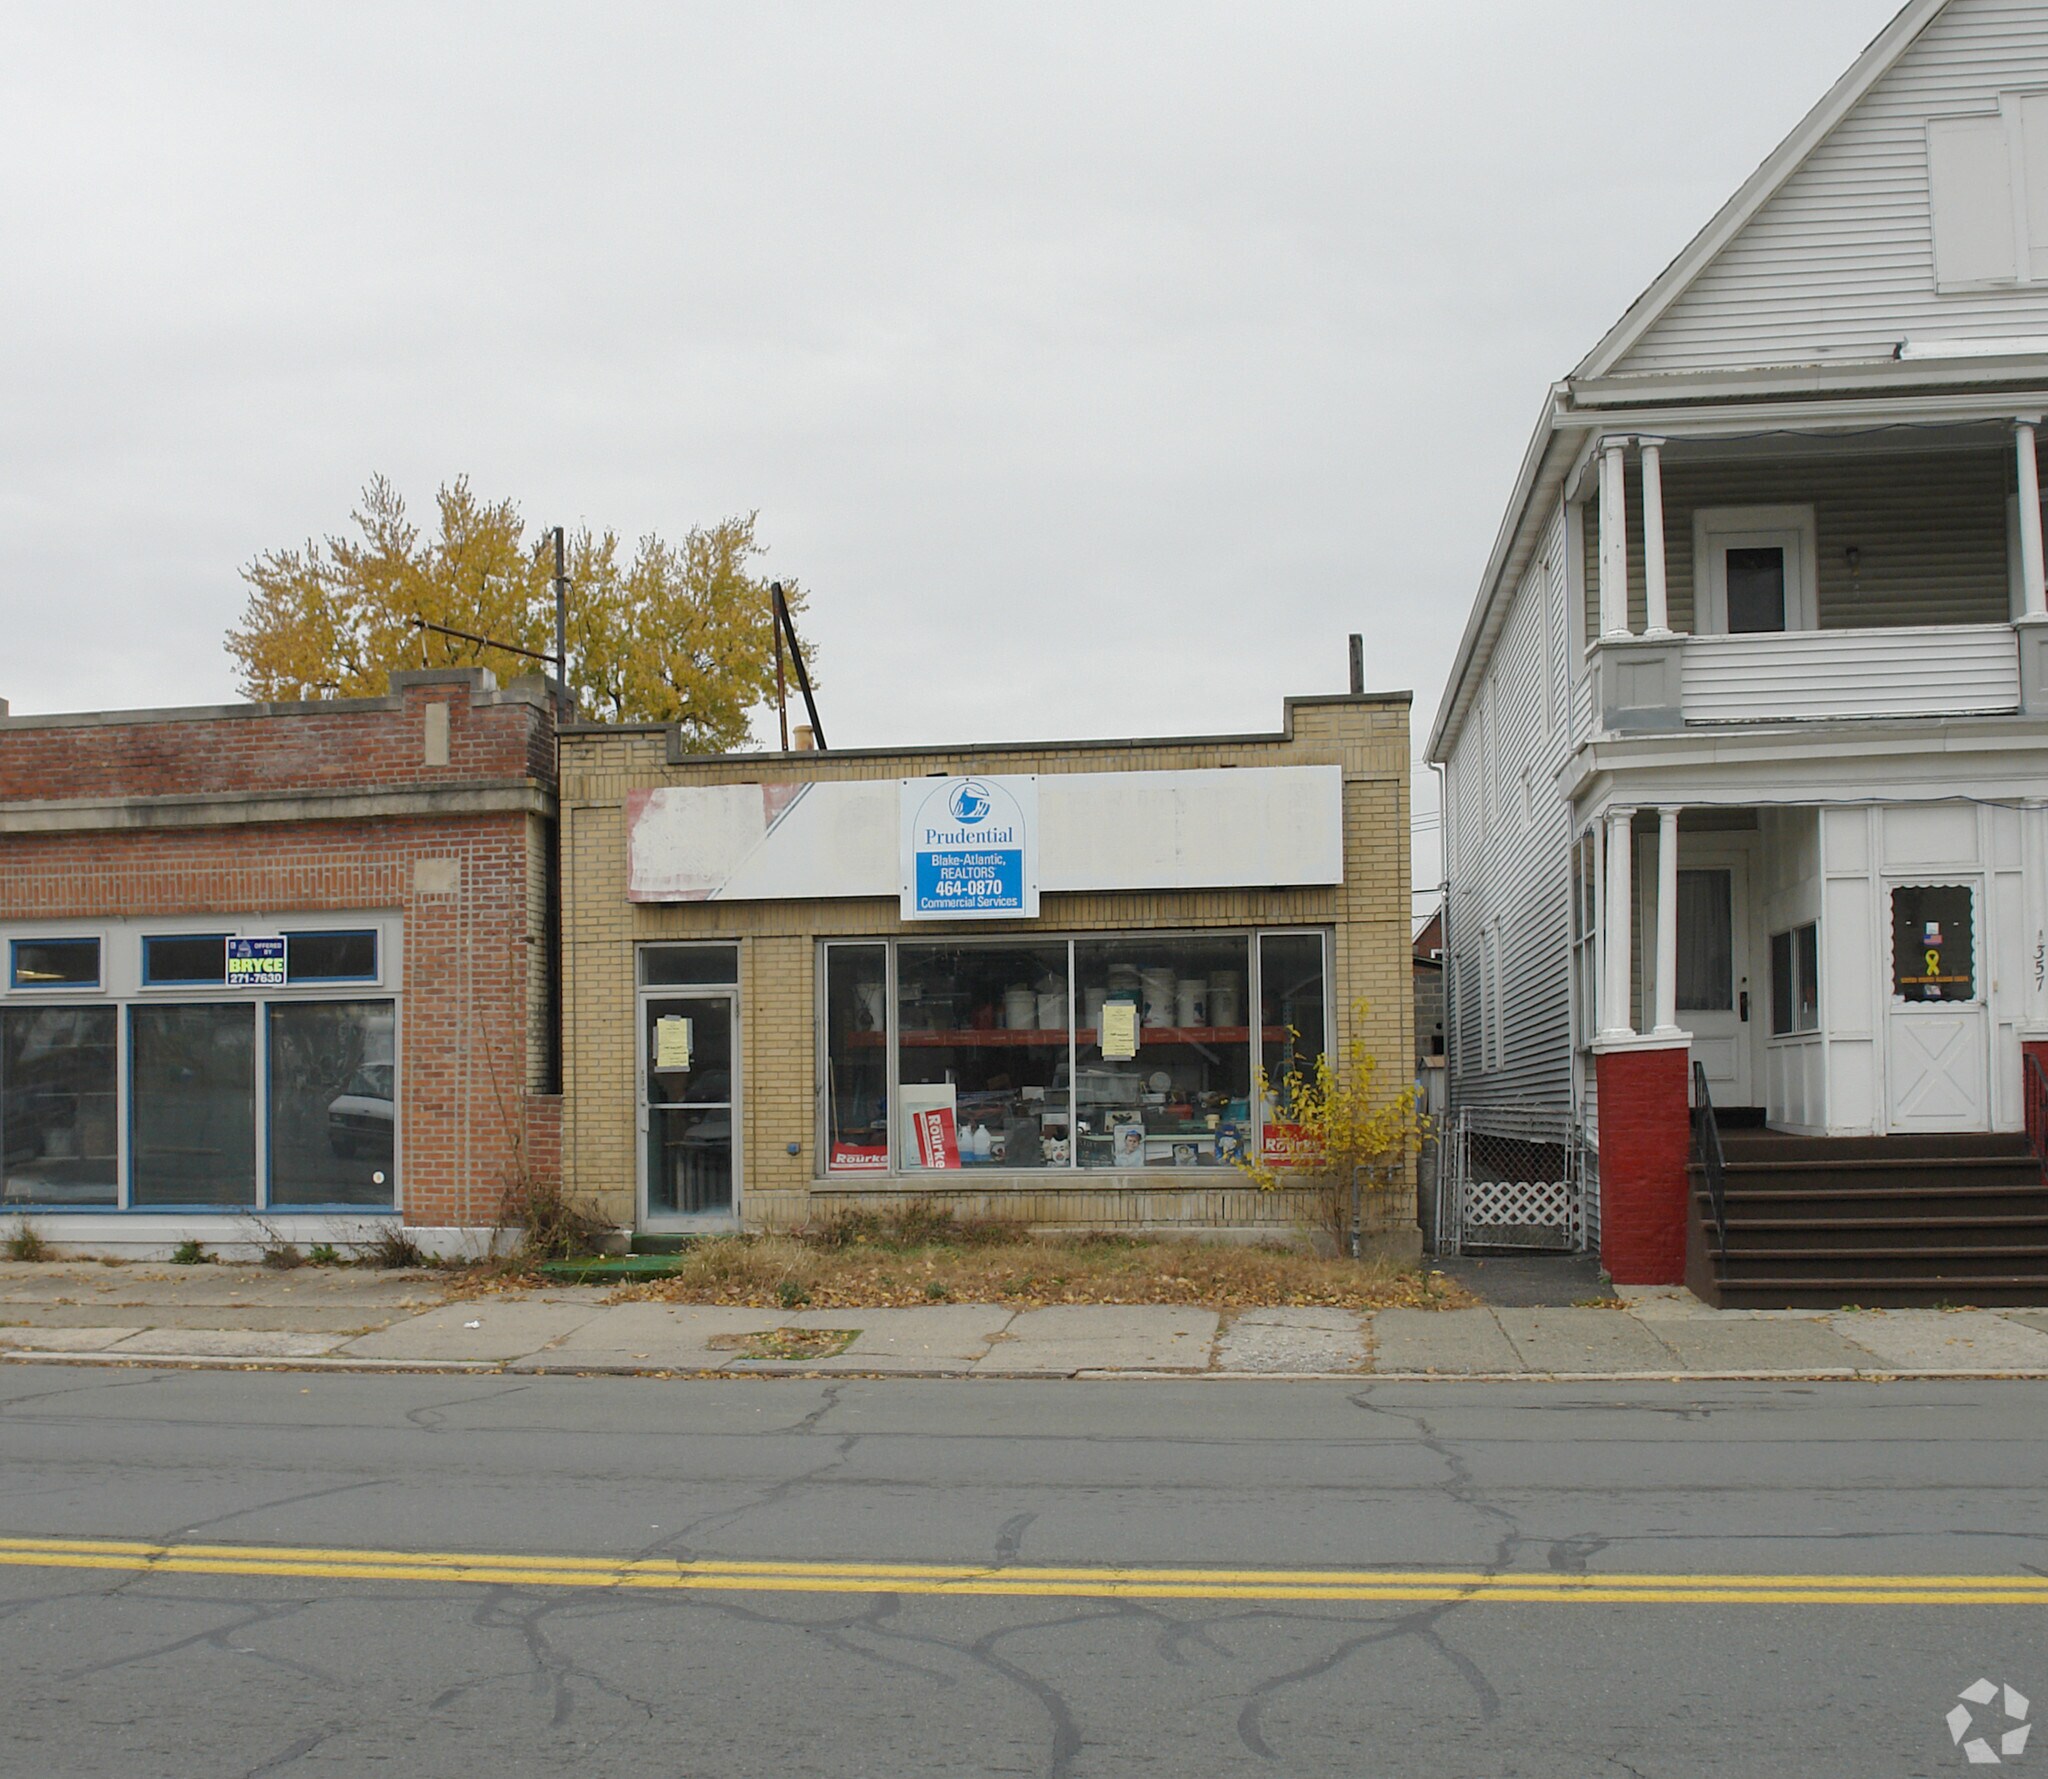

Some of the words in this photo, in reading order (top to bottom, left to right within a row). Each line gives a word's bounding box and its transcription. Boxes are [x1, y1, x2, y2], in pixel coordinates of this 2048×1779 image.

[925, 827, 1013, 845] Prudential
[931, 853, 1007, 867] Blake-Atlantic,
[941, 866, 996, 880] REALTORS
[935, 880, 1002, 896] 464-0870
[921, 898, 976, 909] Commercial
[977, 895, 1018, 908] Services
[229, 958, 284, 973] BRYCE
[230, 973, 282, 983] 271-7630
[927, 1113, 946, 1168] Rourke
[836, 1152, 888, 1163] Rourke
